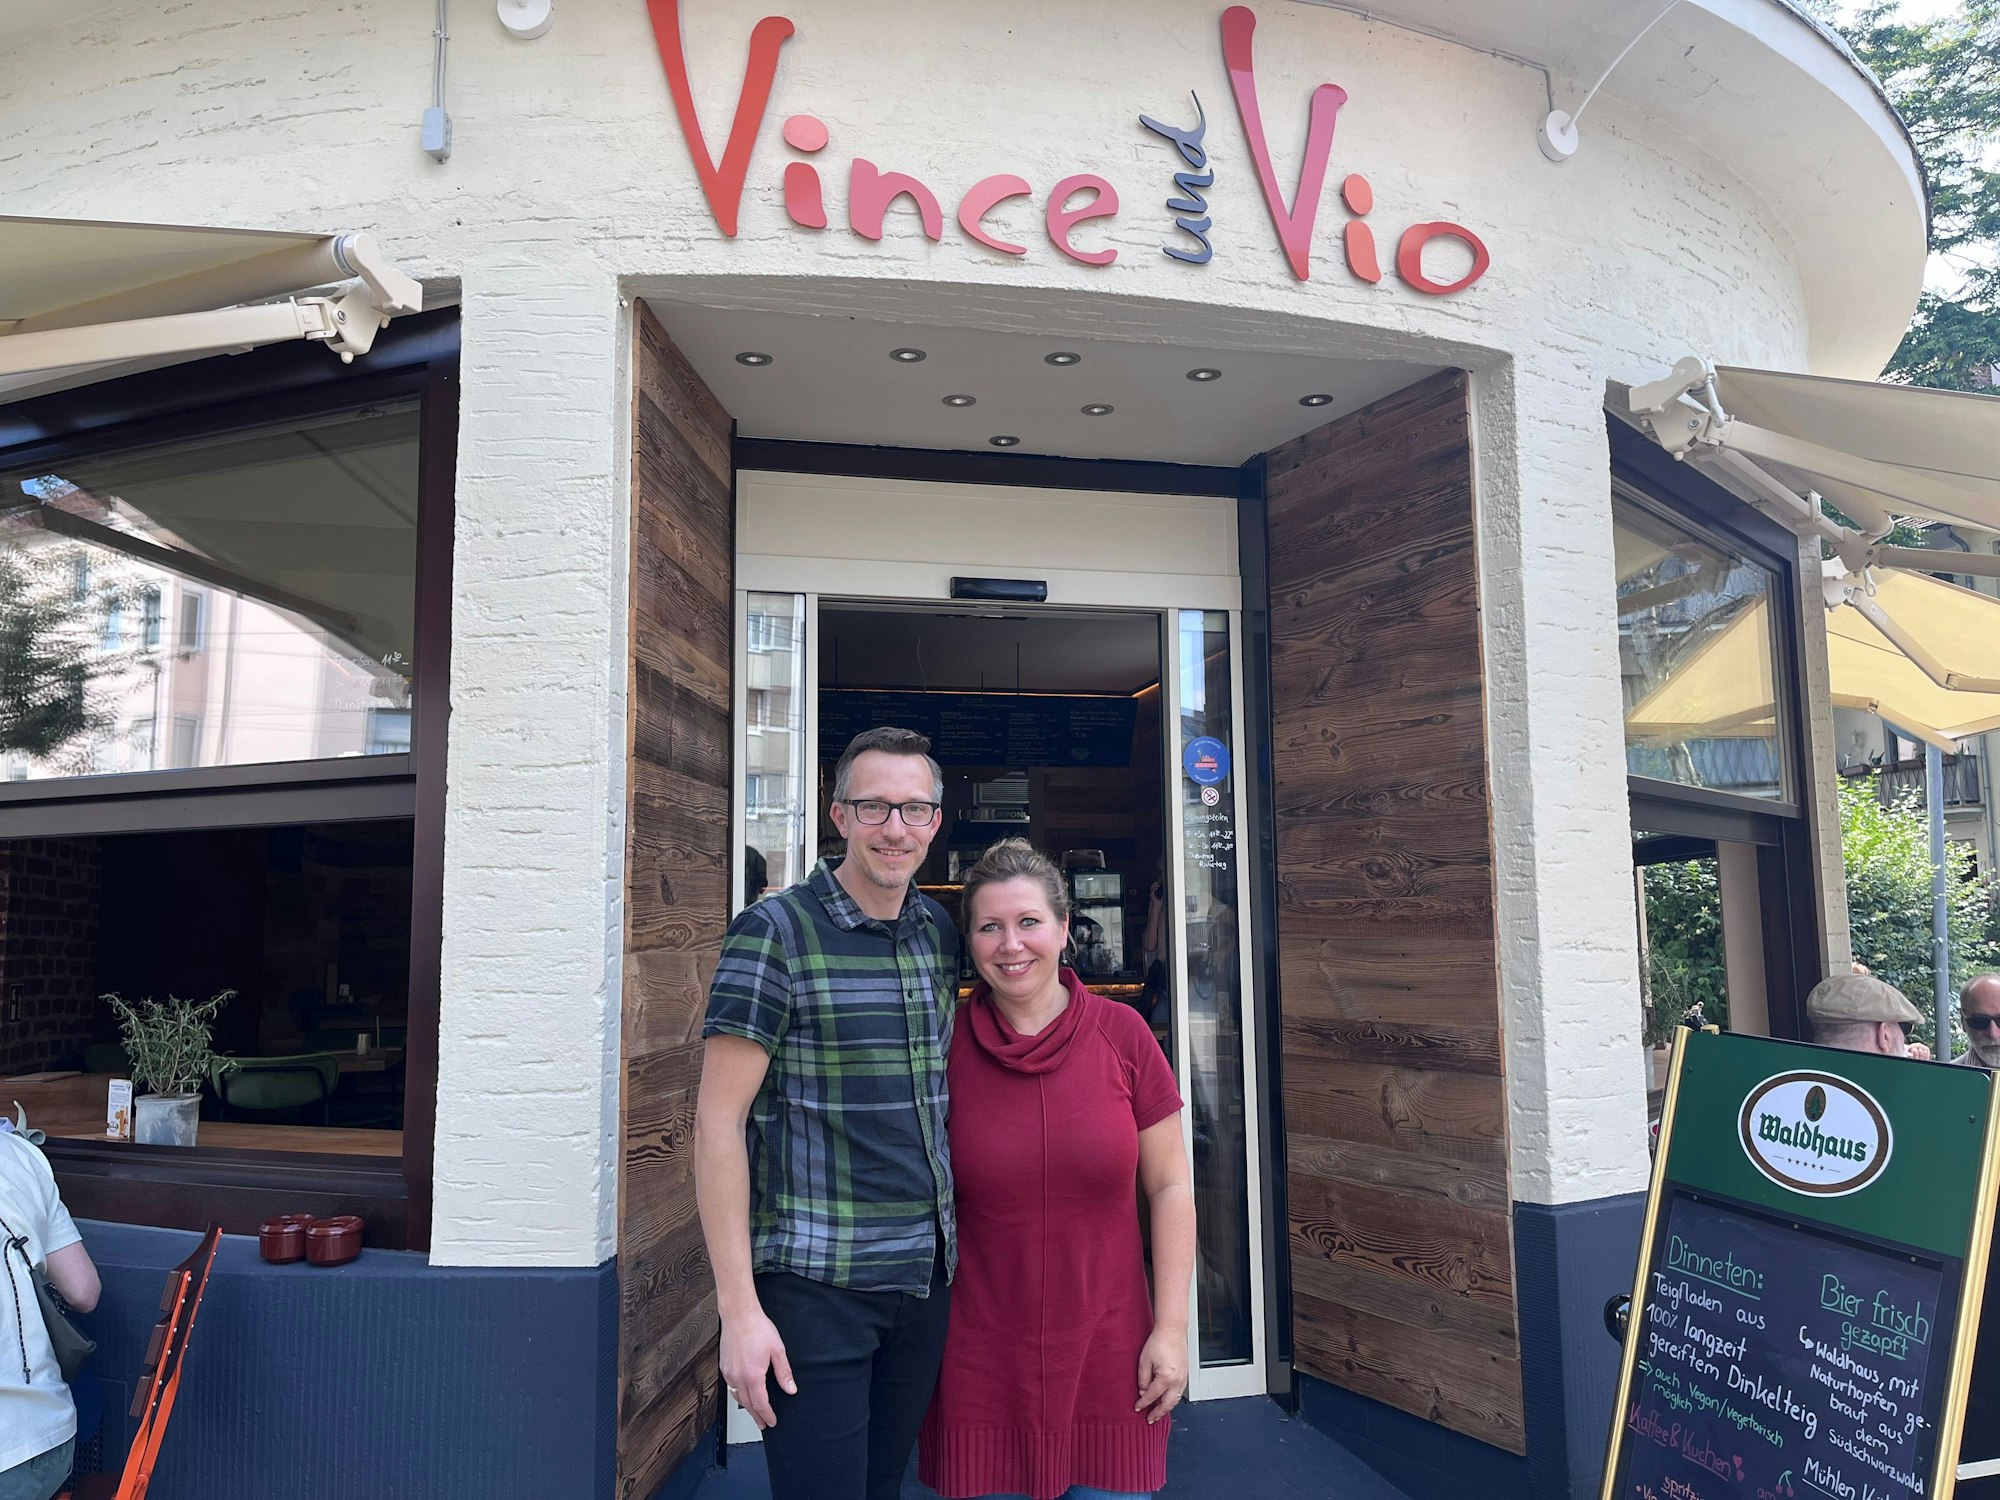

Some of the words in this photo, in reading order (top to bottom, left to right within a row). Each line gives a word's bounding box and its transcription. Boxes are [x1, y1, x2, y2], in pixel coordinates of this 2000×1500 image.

[646, 0, 1119, 265] Vince
[1139, 89, 1214, 264] und
[1220, 5, 1490, 296] Vio
[1758, 1113, 1867, 1163] Waldhaus
[1669, 1235, 1764, 1289] Dinneten:
[1653, 1272, 1723, 1314] Teigfladen
[1736, 1308, 1766, 1330] aus
[1821, 1273, 1864, 1315] Bier
[1872, 1290, 1929, 1342] frisch
[1646, 1303, 1678, 1329] 100%
[1684, 1315, 1747, 1361] langzeit
[1841, 1321, 1908, 1357] gezapft
[1649, 1332, 1720, 1380] gereiftem
[1727, 1364, 1818, 1440] Dinkelteig
[1653, 1384, 1693, 1414] möglich
[1655, 1368, 1680, 1389] auch
[1816, 1341, 1884, 1389] Waldhaus,
[1888, 1376, 1919, 1399] mit
[1809, 1364, 1898, 1417] Naturhopfen
[1904, 1412, 1931, 1435] ge-
[1829, 1393, 1868, 1425] braut
[1878, 1423, 1903, 1445] aus
[1628, 1402, 1669, 1442] Kaffee
[1682, 1428, 1732, 1478] Kuchen
[1828, 1428, 1924, 1495] Südschwarzwald
[1855, 1428, 1889, 1455] dem
[1803, 1456, 1856, 1500] Mühlen
